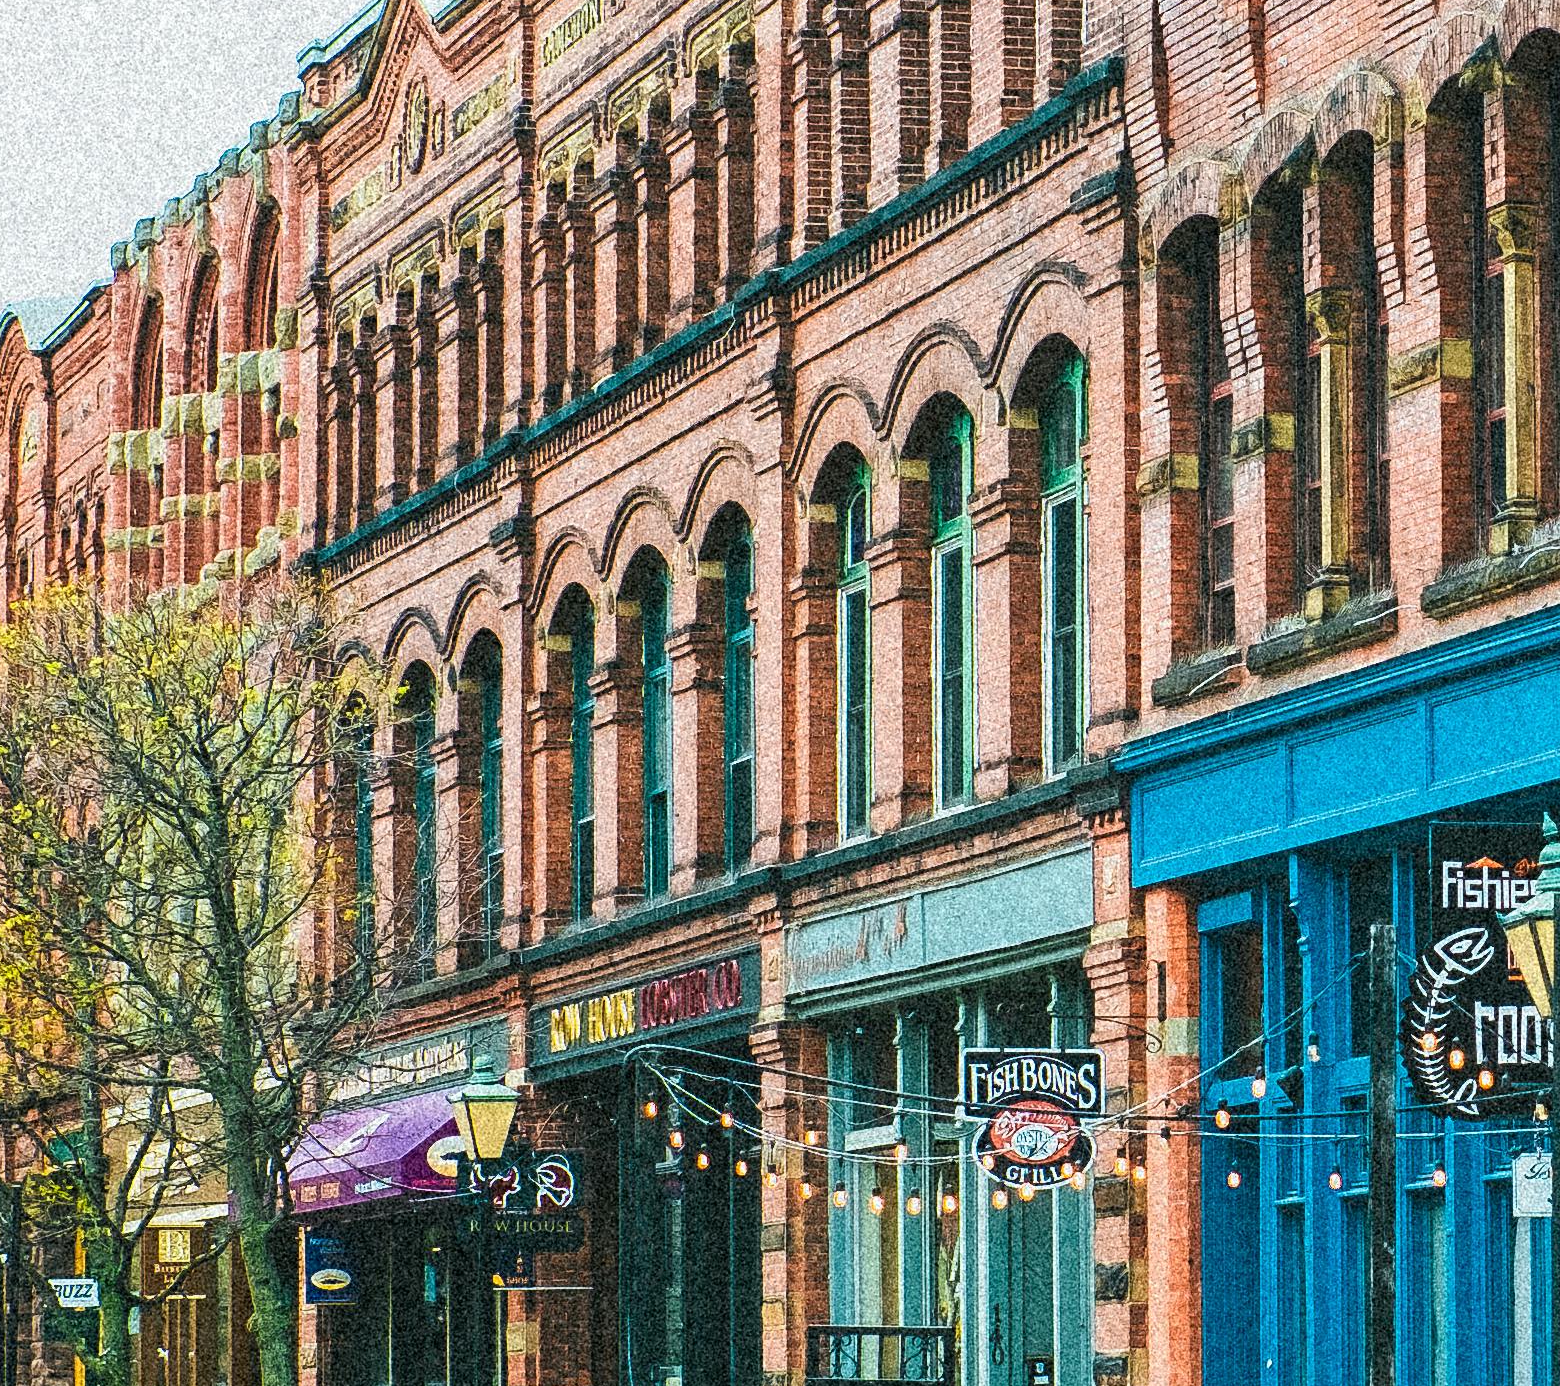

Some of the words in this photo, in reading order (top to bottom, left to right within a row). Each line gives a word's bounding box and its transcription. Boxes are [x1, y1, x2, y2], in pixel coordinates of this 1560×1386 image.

[551, 1001, 584, 1053] ROW
[589, 988, 636, 1043] HOUSE
[641, 969, 709, 1028] LOBSTER
[516, 1220, 574, 1233] HOUSE
[54, 1284, 93, 1299] BUZZ
